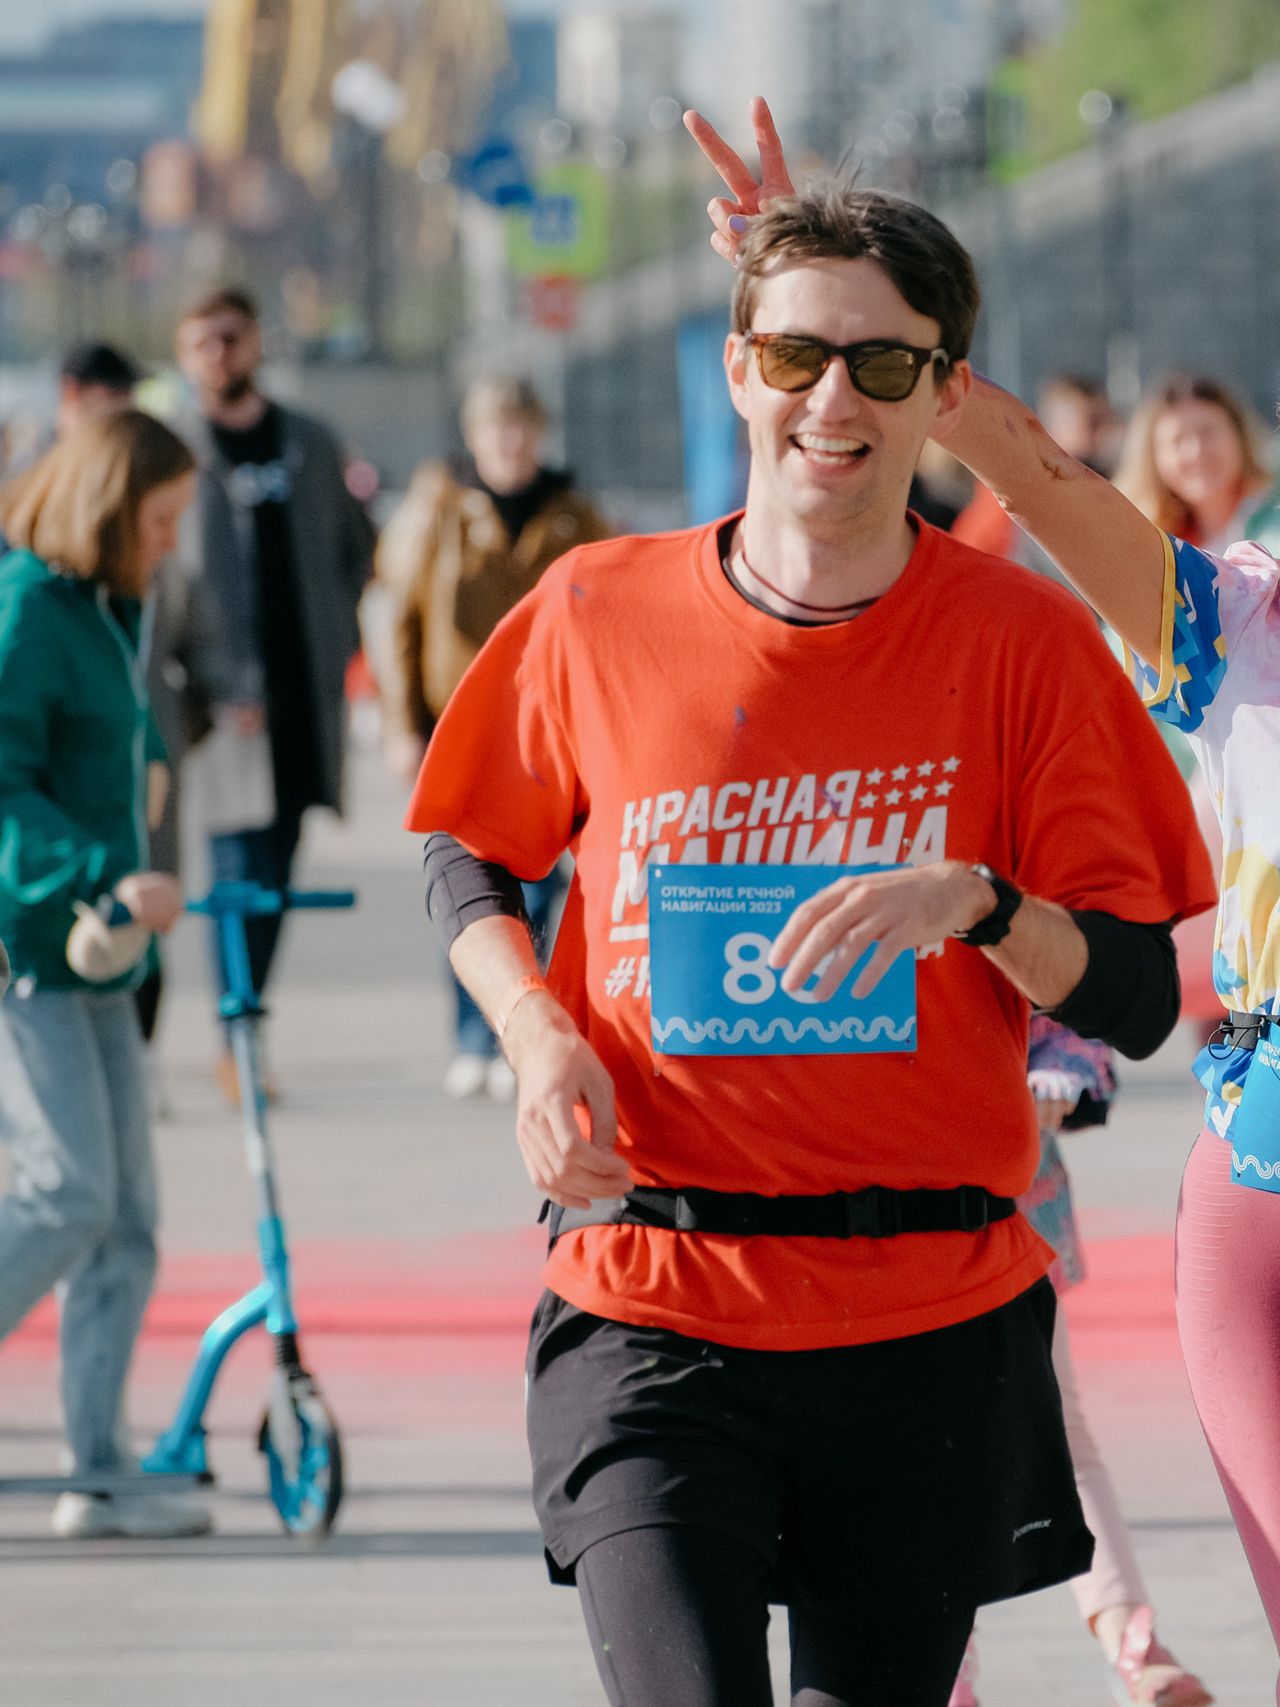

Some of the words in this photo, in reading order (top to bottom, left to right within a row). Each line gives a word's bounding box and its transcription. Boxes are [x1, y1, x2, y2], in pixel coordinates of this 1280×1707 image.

[620, 769, 861, 848] КРАСНАЯ
[660, 885, 735, 900] ОТКРЫТИЕ
[737, 884, 795, 899] РЕЧНОЙ
[661, 901, 747, 914] НАВИГАЦИИ
[749, 901, 782, 914] 2023
